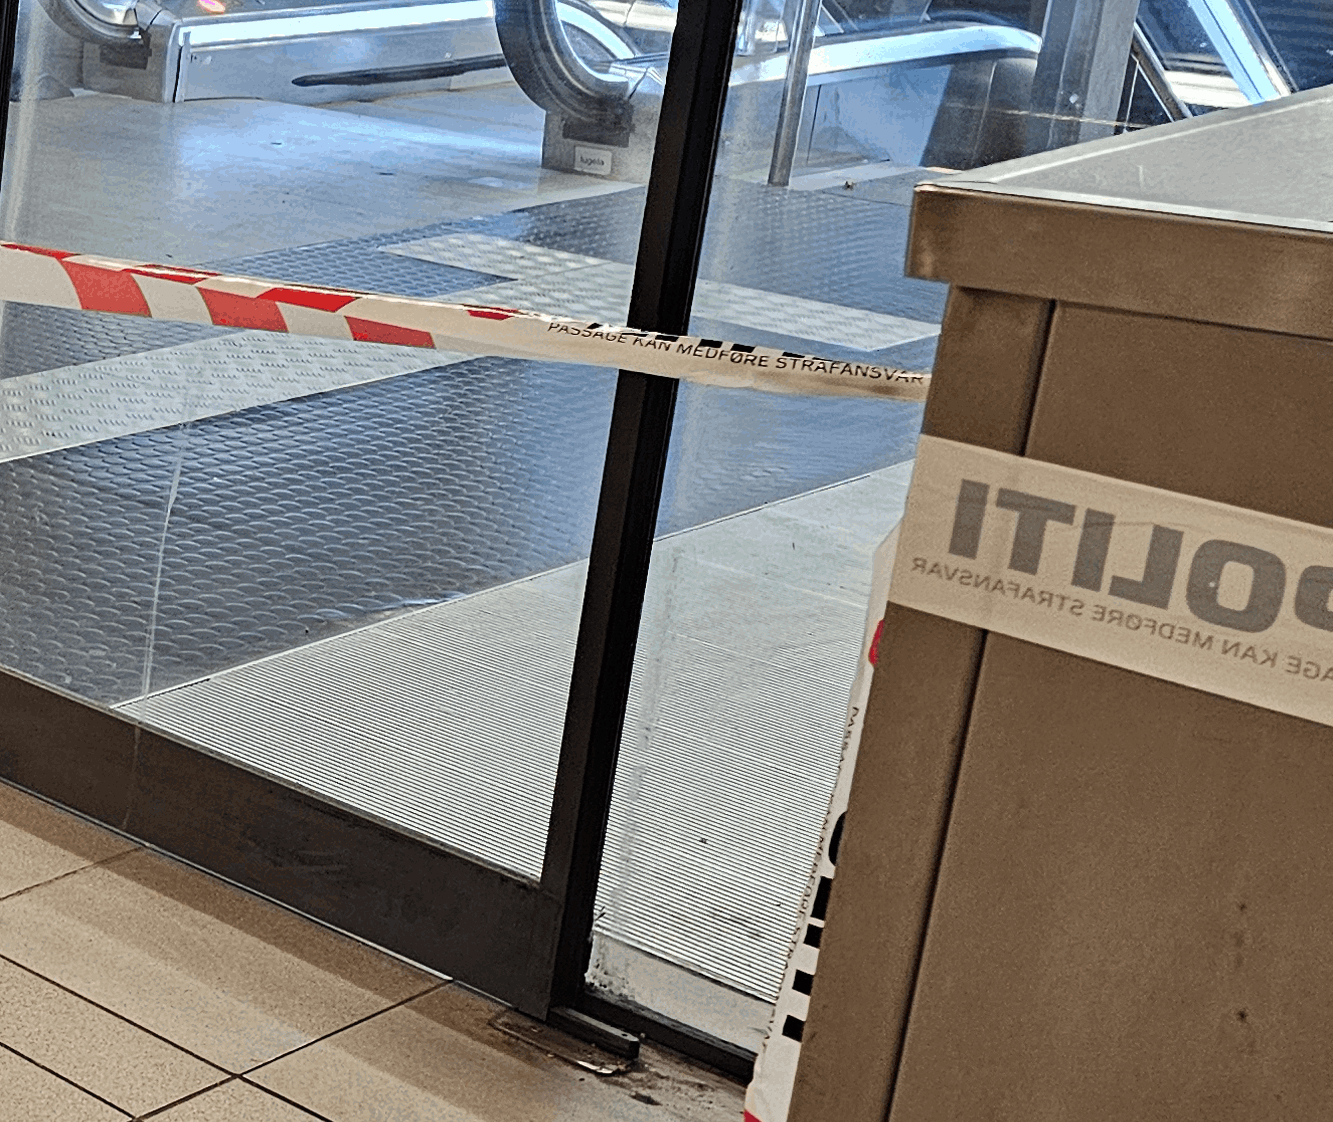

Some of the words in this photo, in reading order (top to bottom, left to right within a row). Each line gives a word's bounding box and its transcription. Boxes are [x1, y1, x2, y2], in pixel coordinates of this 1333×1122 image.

[547, 322, 628, 345] PASSAGE
[631, 335, 671, 352] KAN
[675, 340, 770, 368] MEDFØRE
[775, 357, 926, 385] STRAFANSVAR
